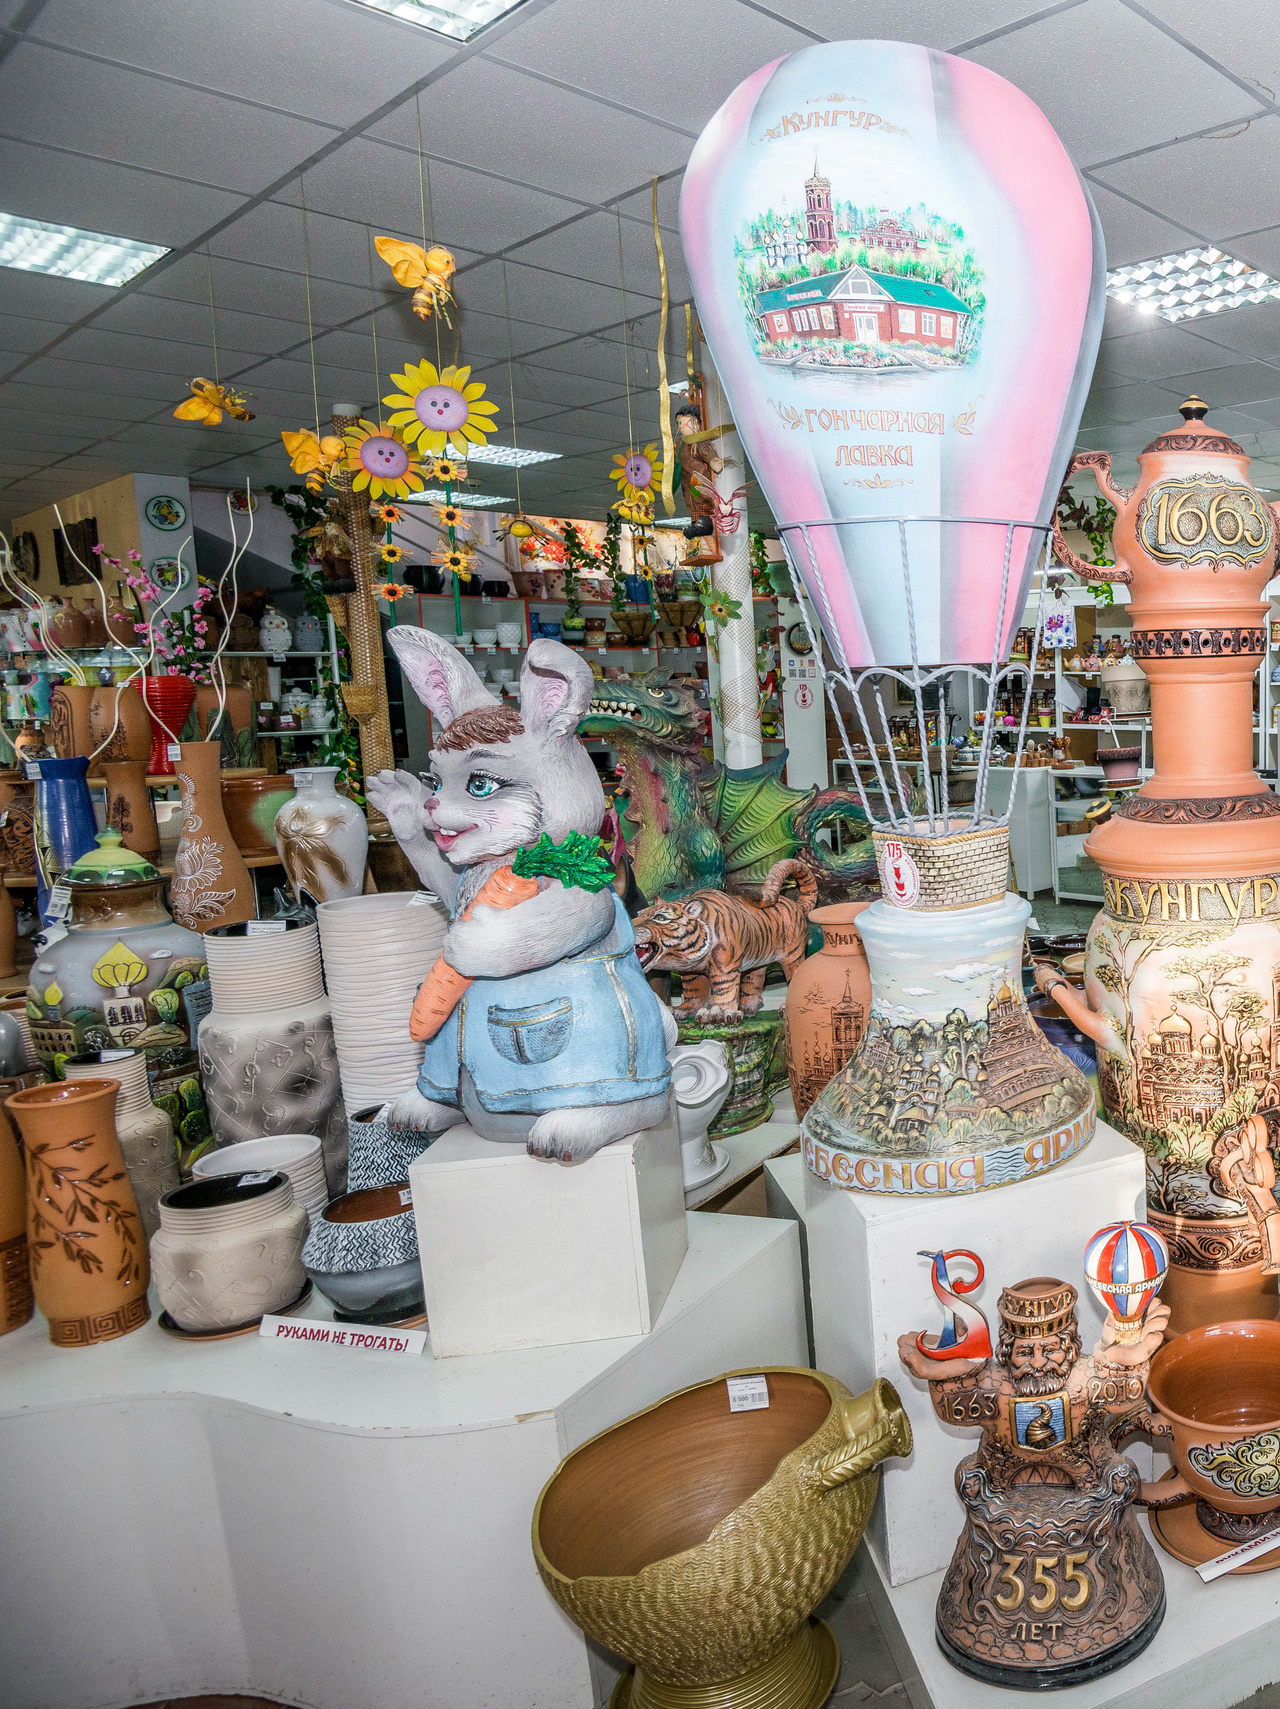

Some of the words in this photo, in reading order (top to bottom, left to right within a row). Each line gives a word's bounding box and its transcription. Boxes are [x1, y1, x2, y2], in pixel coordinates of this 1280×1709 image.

[782, 110, 882, 136] КУНГУР
[1153, 492, 1266, 547] 1663
[886, 842, 902, 859] 175
[1113, 878, 1279, 928] КУНГУР
[802, 1135, 985, 1190] ЕБЕСНАЯ
[1003, 1290, 1072, 1316] КУНГУР
[276, 1325, 330, 1343] РУКАМИ
[331, 1330, 347, 1345] НЕ
[350, 1333, 409, 1353] ТРОГАТЬ!
[1091, 1378, 1143, 1403] 2019
[942, 1393, 998, 1420] 1663
[996, 1551, 1092, 1613] 355
[1010, 1622, 1062, 1640] ЛЕТ
